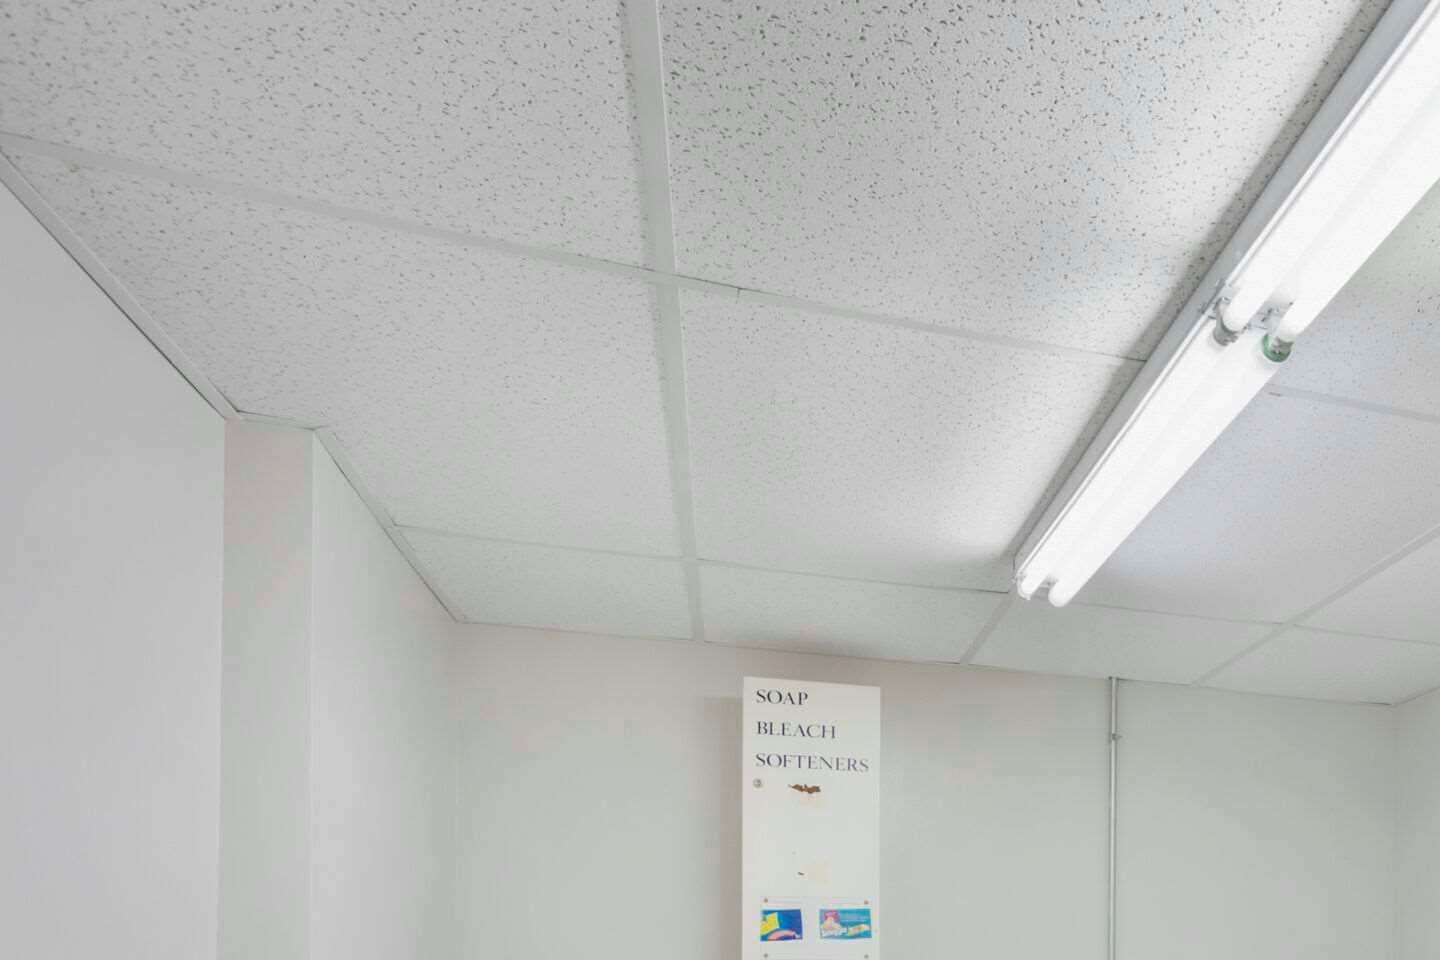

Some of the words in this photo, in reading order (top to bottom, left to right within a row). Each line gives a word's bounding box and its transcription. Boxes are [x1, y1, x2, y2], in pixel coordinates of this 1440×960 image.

[756, 689, 808, 706] SOAP
[757, 721, 836, 739] BLEACH
[756, 753, 869, 772] SOFTENERS
